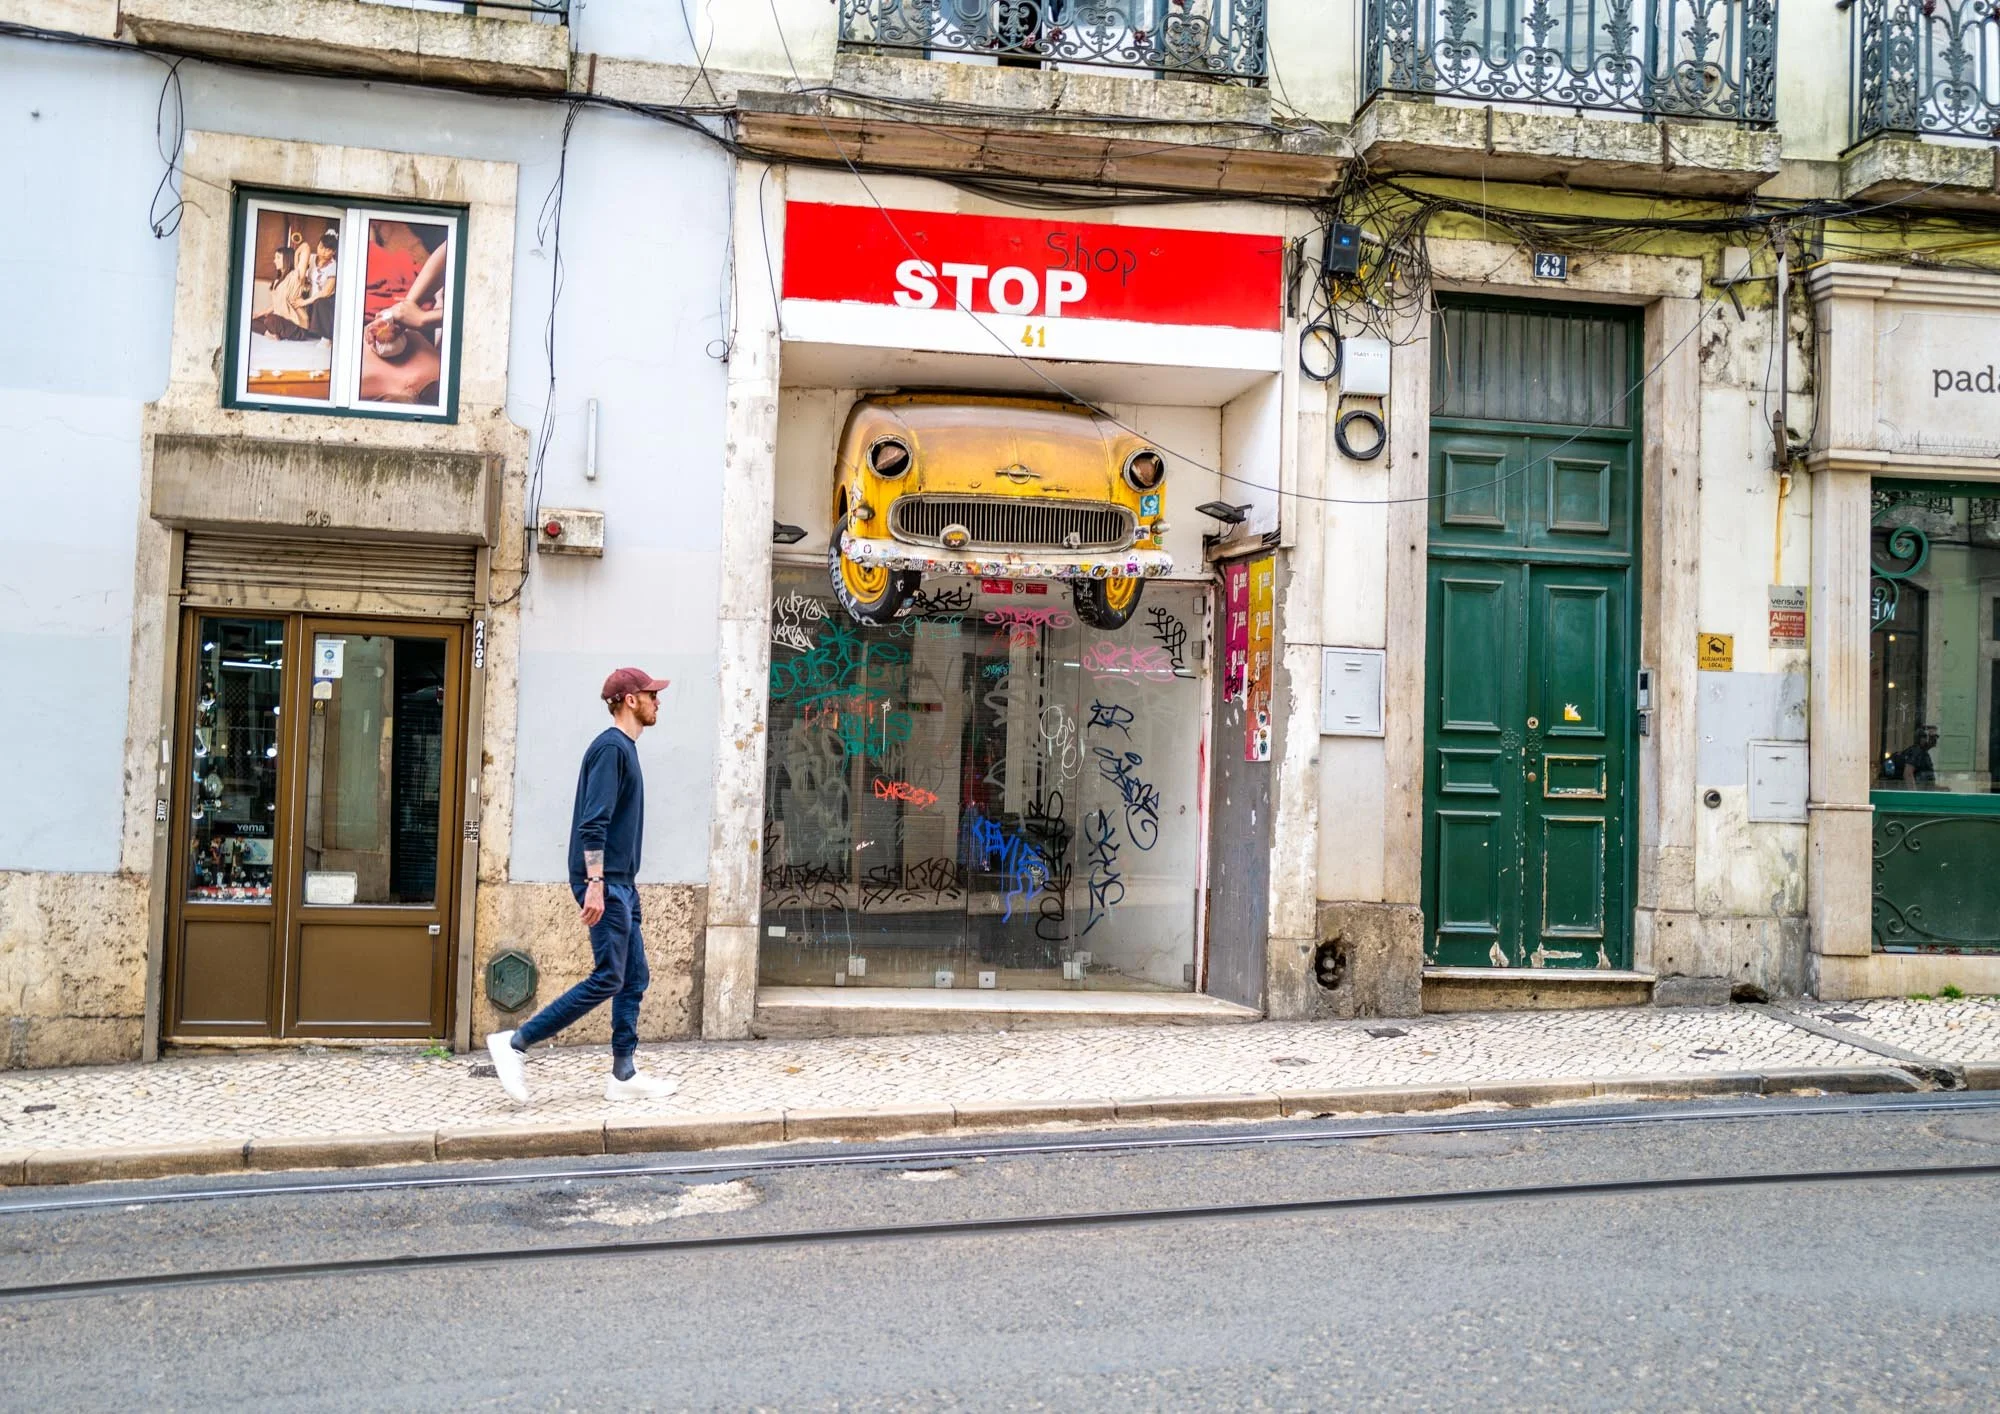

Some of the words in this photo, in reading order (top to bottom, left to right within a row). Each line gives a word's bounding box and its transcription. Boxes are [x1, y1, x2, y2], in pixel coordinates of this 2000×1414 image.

[1046, 232, 1137, 287] Shop
[1540, 255, 1560, 276] 43
[893, 259, 1088, 317] STOP
[1021, 324, 1046, 348] 41
[1932, 364, 2000, 398] pad
